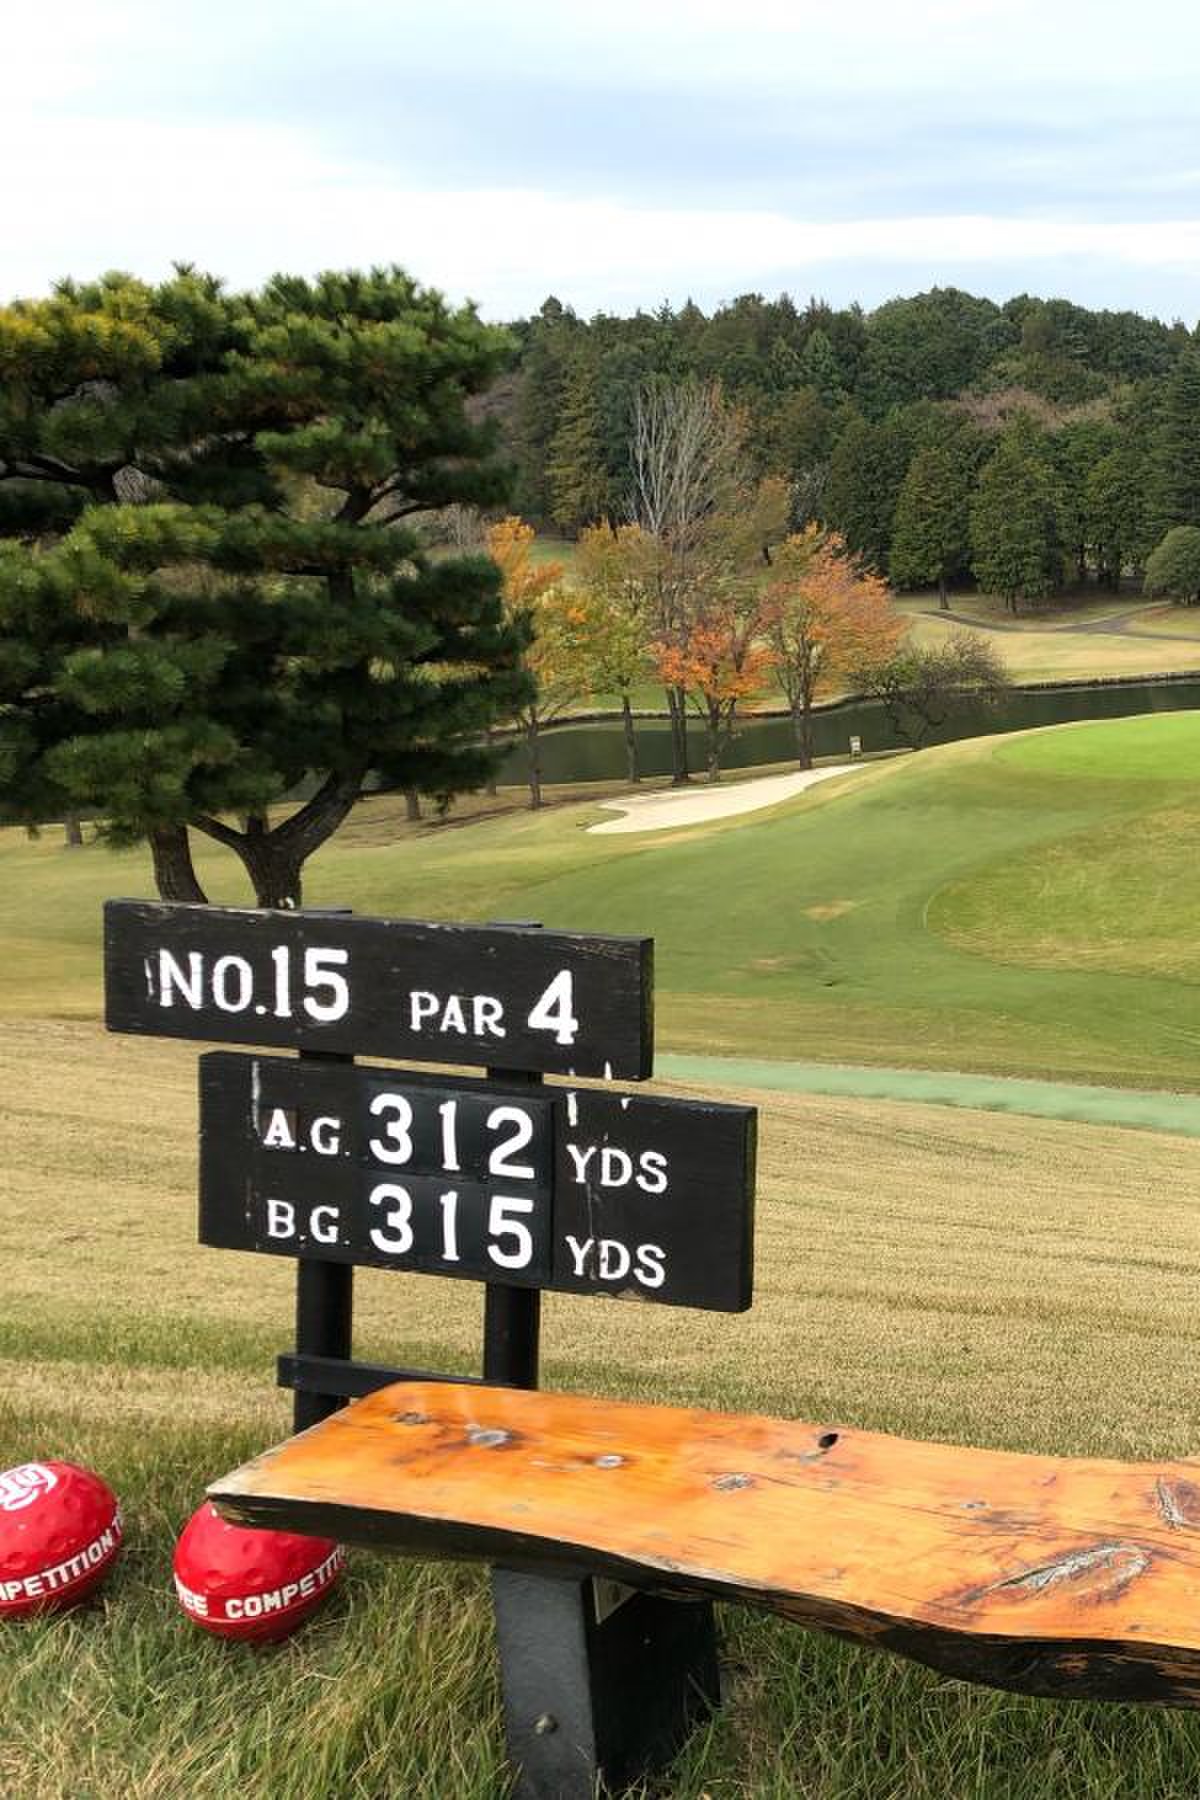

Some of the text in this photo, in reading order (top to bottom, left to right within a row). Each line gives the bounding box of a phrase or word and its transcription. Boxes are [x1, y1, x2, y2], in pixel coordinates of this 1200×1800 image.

[158, 945, 579, 1044] NO.15 PAR 4
[262, 1093, 669, 1194] A.G. 312 YDS
[267, 1183, 667, 1288] B.G. 315 YDS
